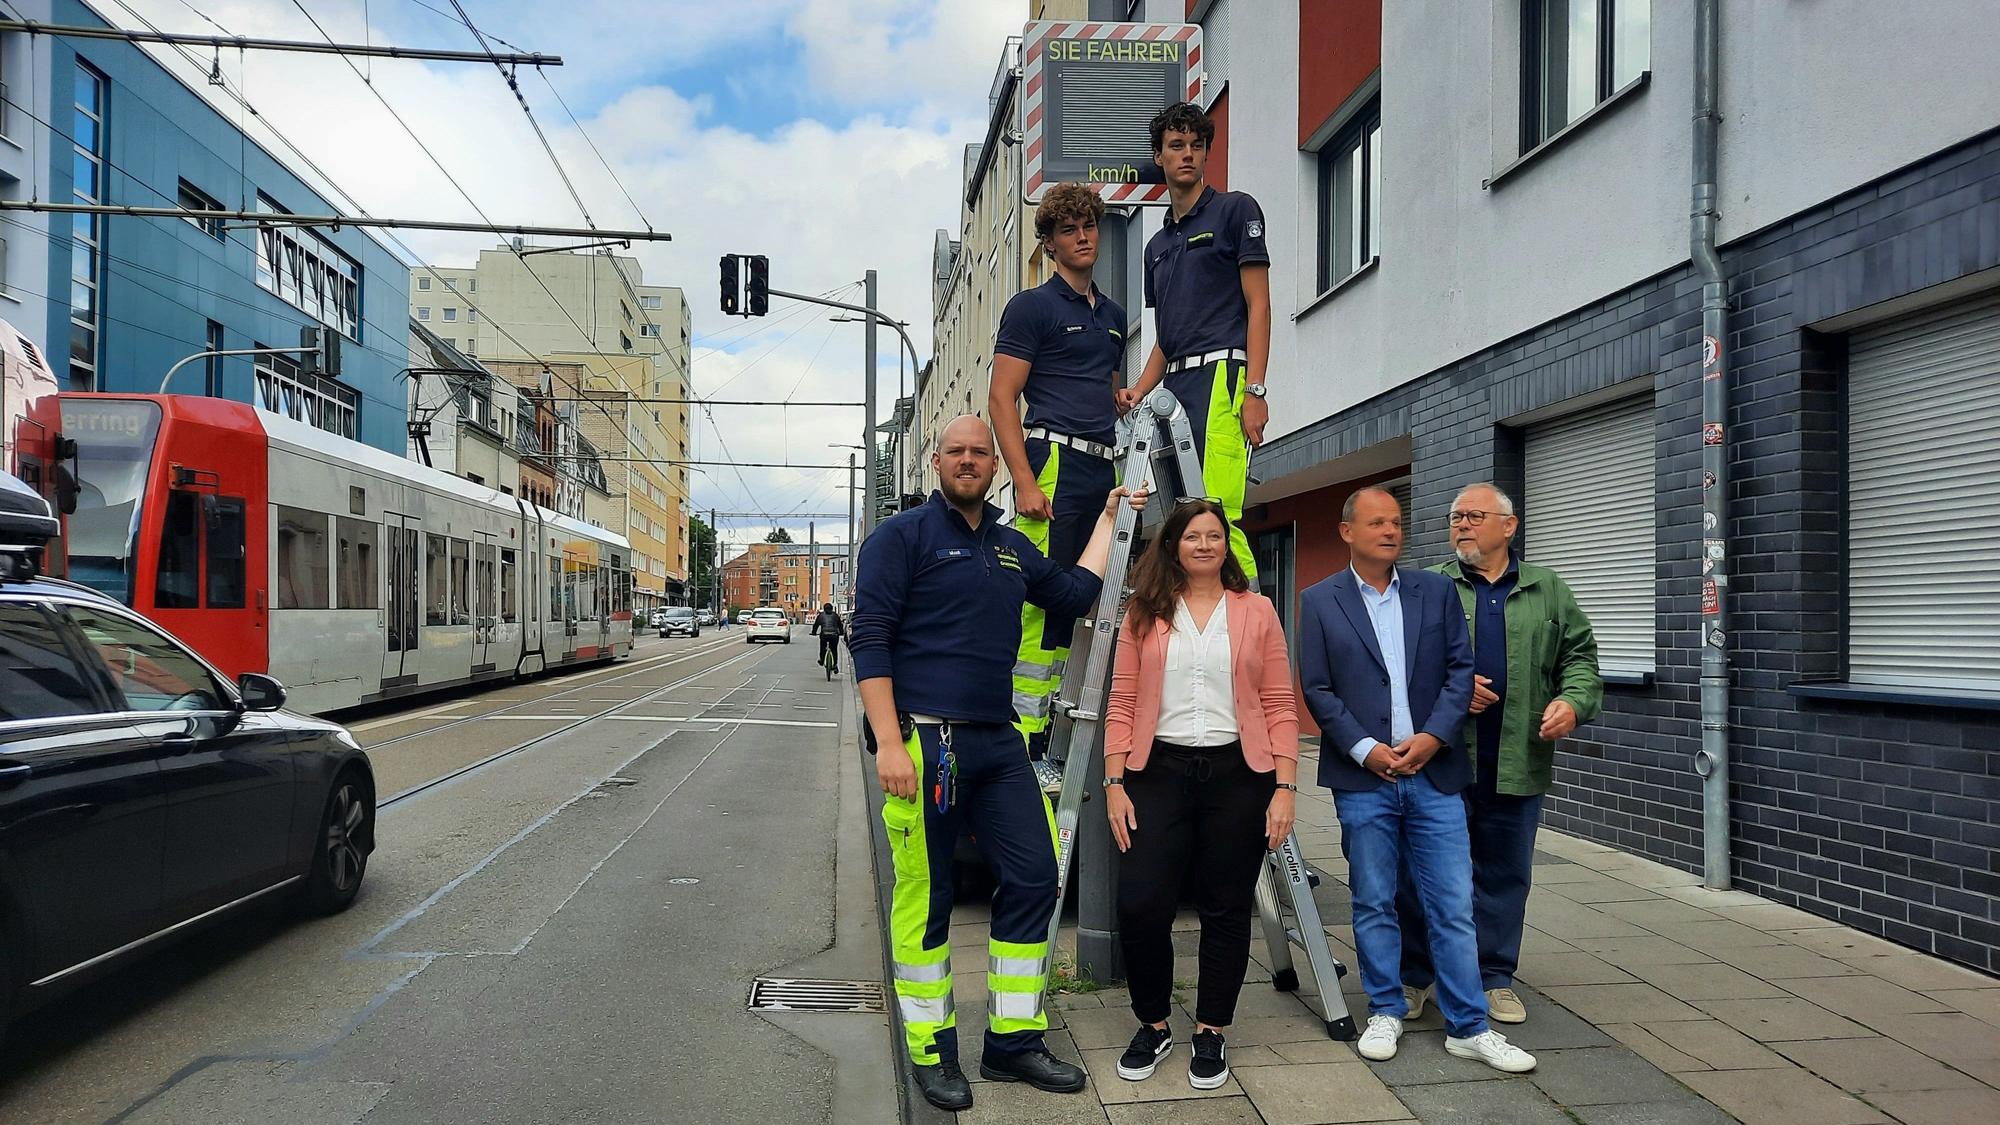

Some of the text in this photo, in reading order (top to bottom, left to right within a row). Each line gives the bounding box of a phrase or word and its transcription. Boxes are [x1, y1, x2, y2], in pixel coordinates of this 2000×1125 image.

[1049, 40, 1179, 62] SIE FAHREN
[1089, 163, 1138, 182] km/h
